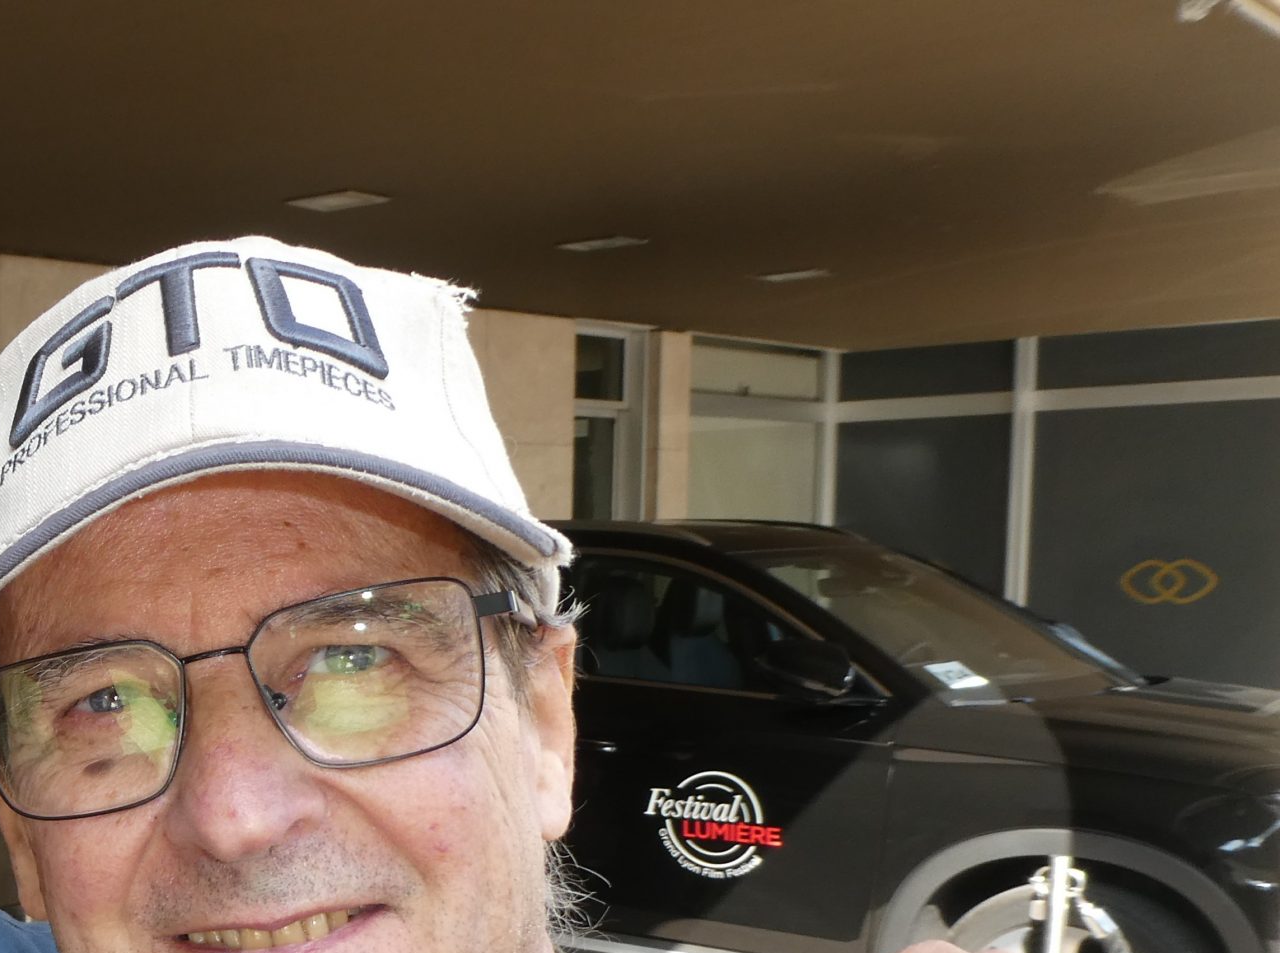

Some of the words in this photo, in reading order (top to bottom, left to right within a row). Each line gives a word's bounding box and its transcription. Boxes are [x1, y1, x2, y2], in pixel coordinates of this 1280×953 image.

[9, 251, 389, 450] GTO
[0, 359, 210, 487] PROFESSIONAL
[222, 344, 396, 411] TIMEPIECES
[643, 787, 744, 823] Festival
[682, 820, 784, 848] LUMIÈRE
